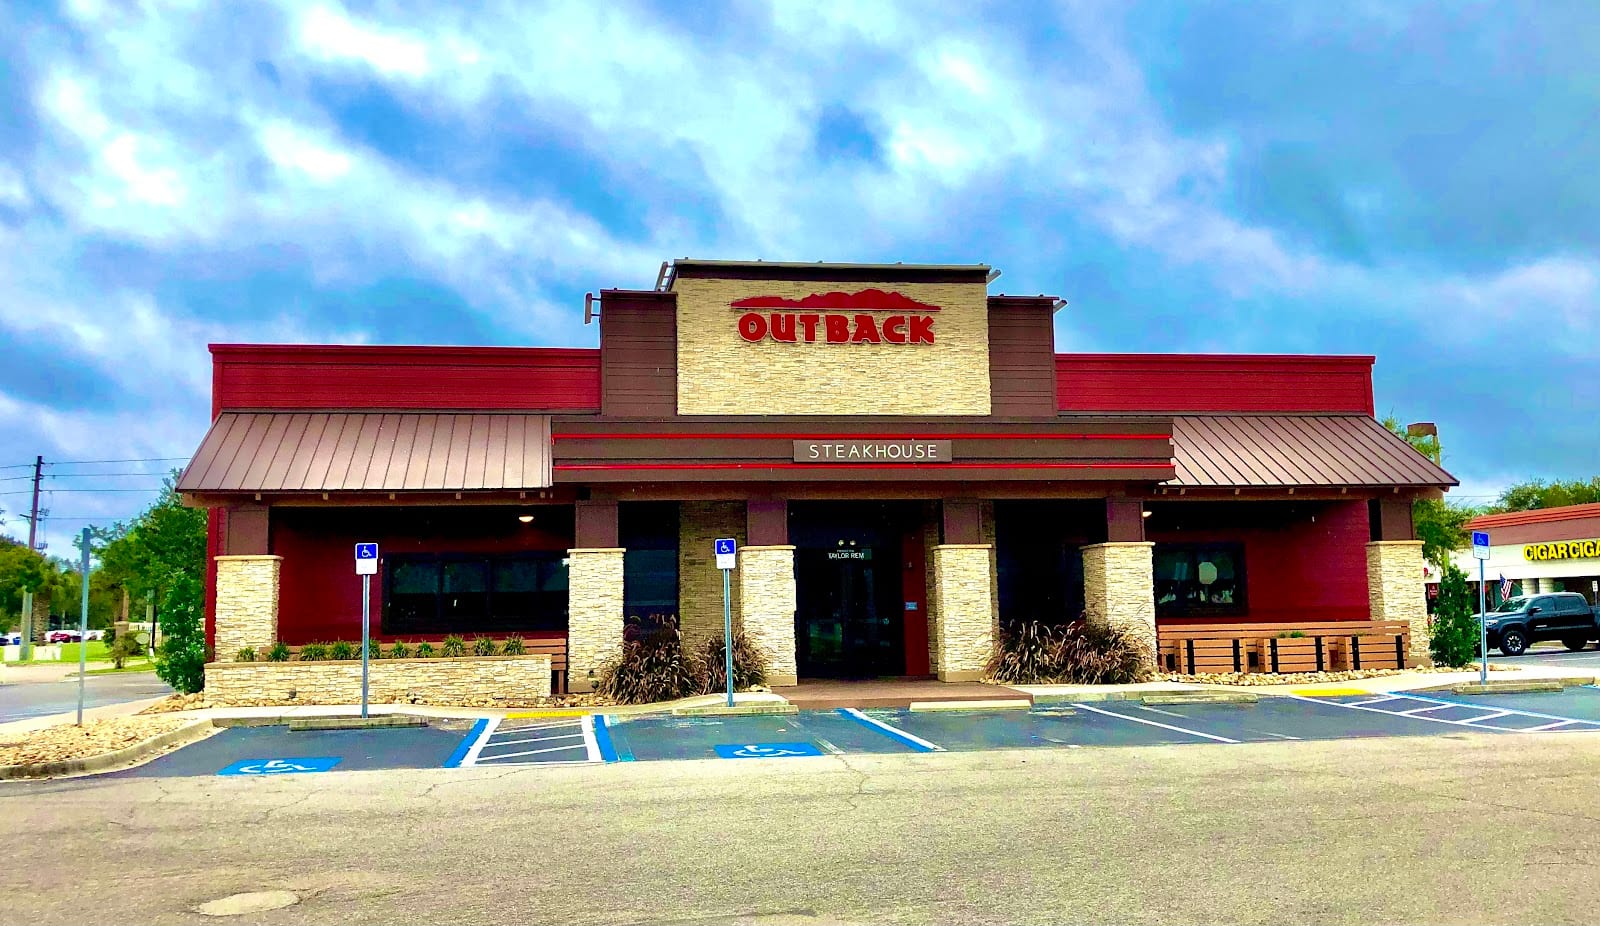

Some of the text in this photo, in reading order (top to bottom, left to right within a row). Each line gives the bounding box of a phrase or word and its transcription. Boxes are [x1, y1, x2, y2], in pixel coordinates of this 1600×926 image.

[738, 312, 935, 344] OUTBACK
[809, 443, 938, 459] STEAKHOUSE
[1524, 543, 1568, 560] CIGAR
